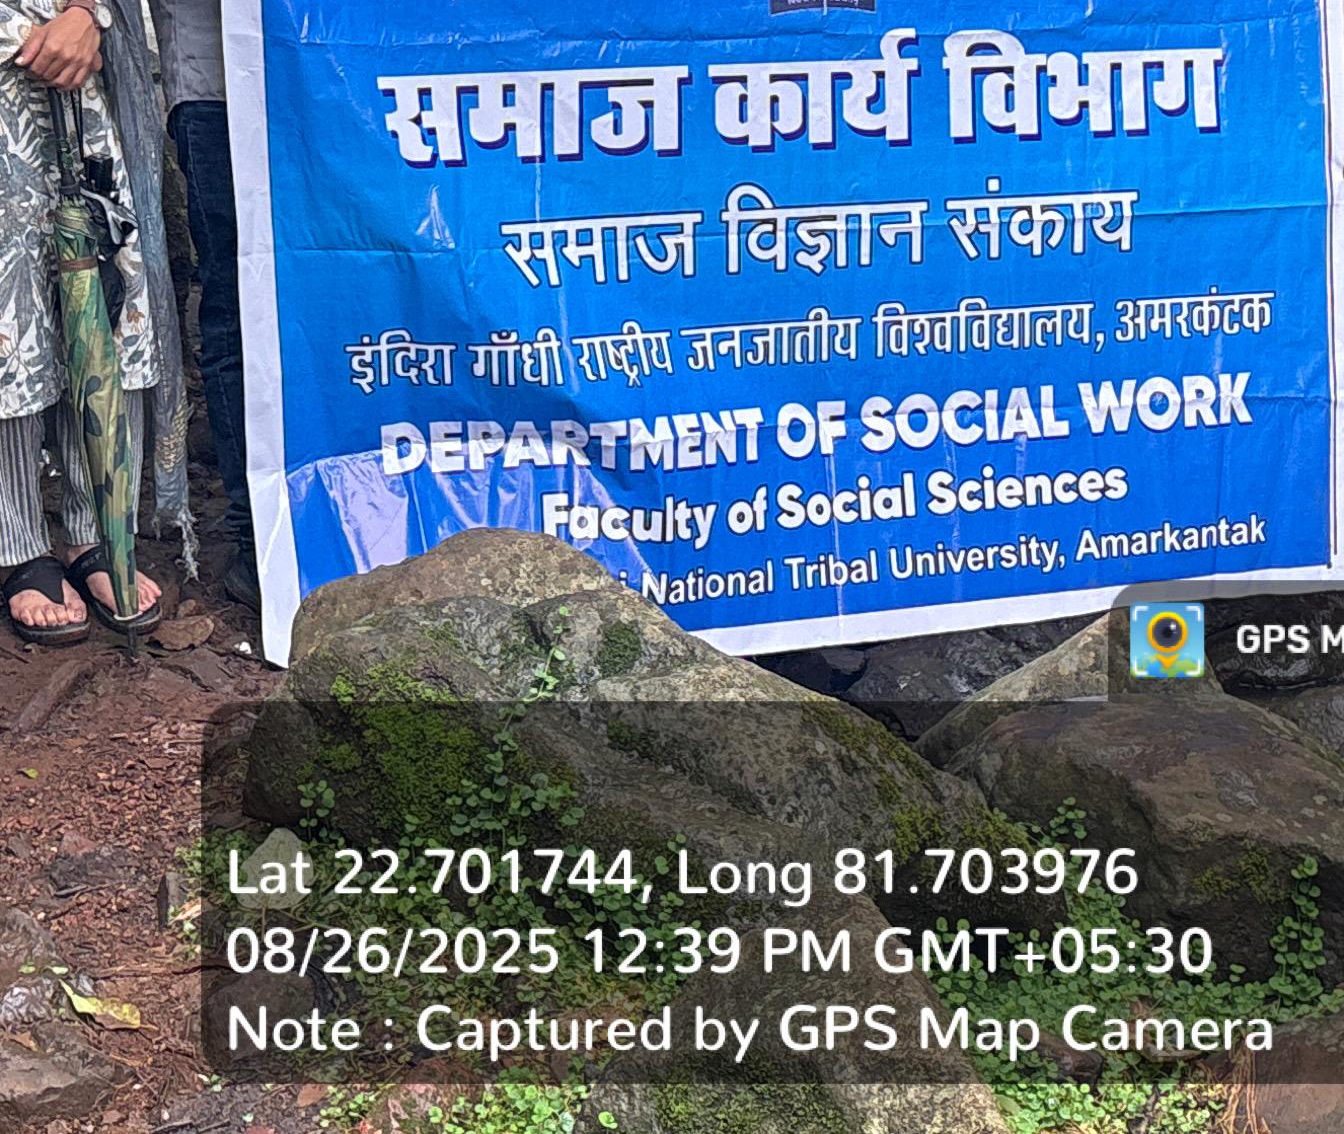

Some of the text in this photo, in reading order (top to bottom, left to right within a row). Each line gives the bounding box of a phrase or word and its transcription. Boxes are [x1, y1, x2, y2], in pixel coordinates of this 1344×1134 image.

[377, 28, 1223, 167] समाज कार्य विभाग
[500, 178, 1139, 287] समाज विज्ञान संकाय
[346, 329, 456, 394] इंदिरा
[572, 320, 672, 386] राष्ट्रीय
[679, 307, 862, 371] जनजातीय
[874, 298, 1106, 359] विश्वविद्यालय,
[1116, 286, 1275, 341] अमरकंटक
[380, 372, 1253, 476] DEPARTMENT OF SOCIAL WORK
[540, 465, 1129, 550] Faculty of Social Sciences
[642, 513, 1266, 605] National Tribal University, Amarkantak
